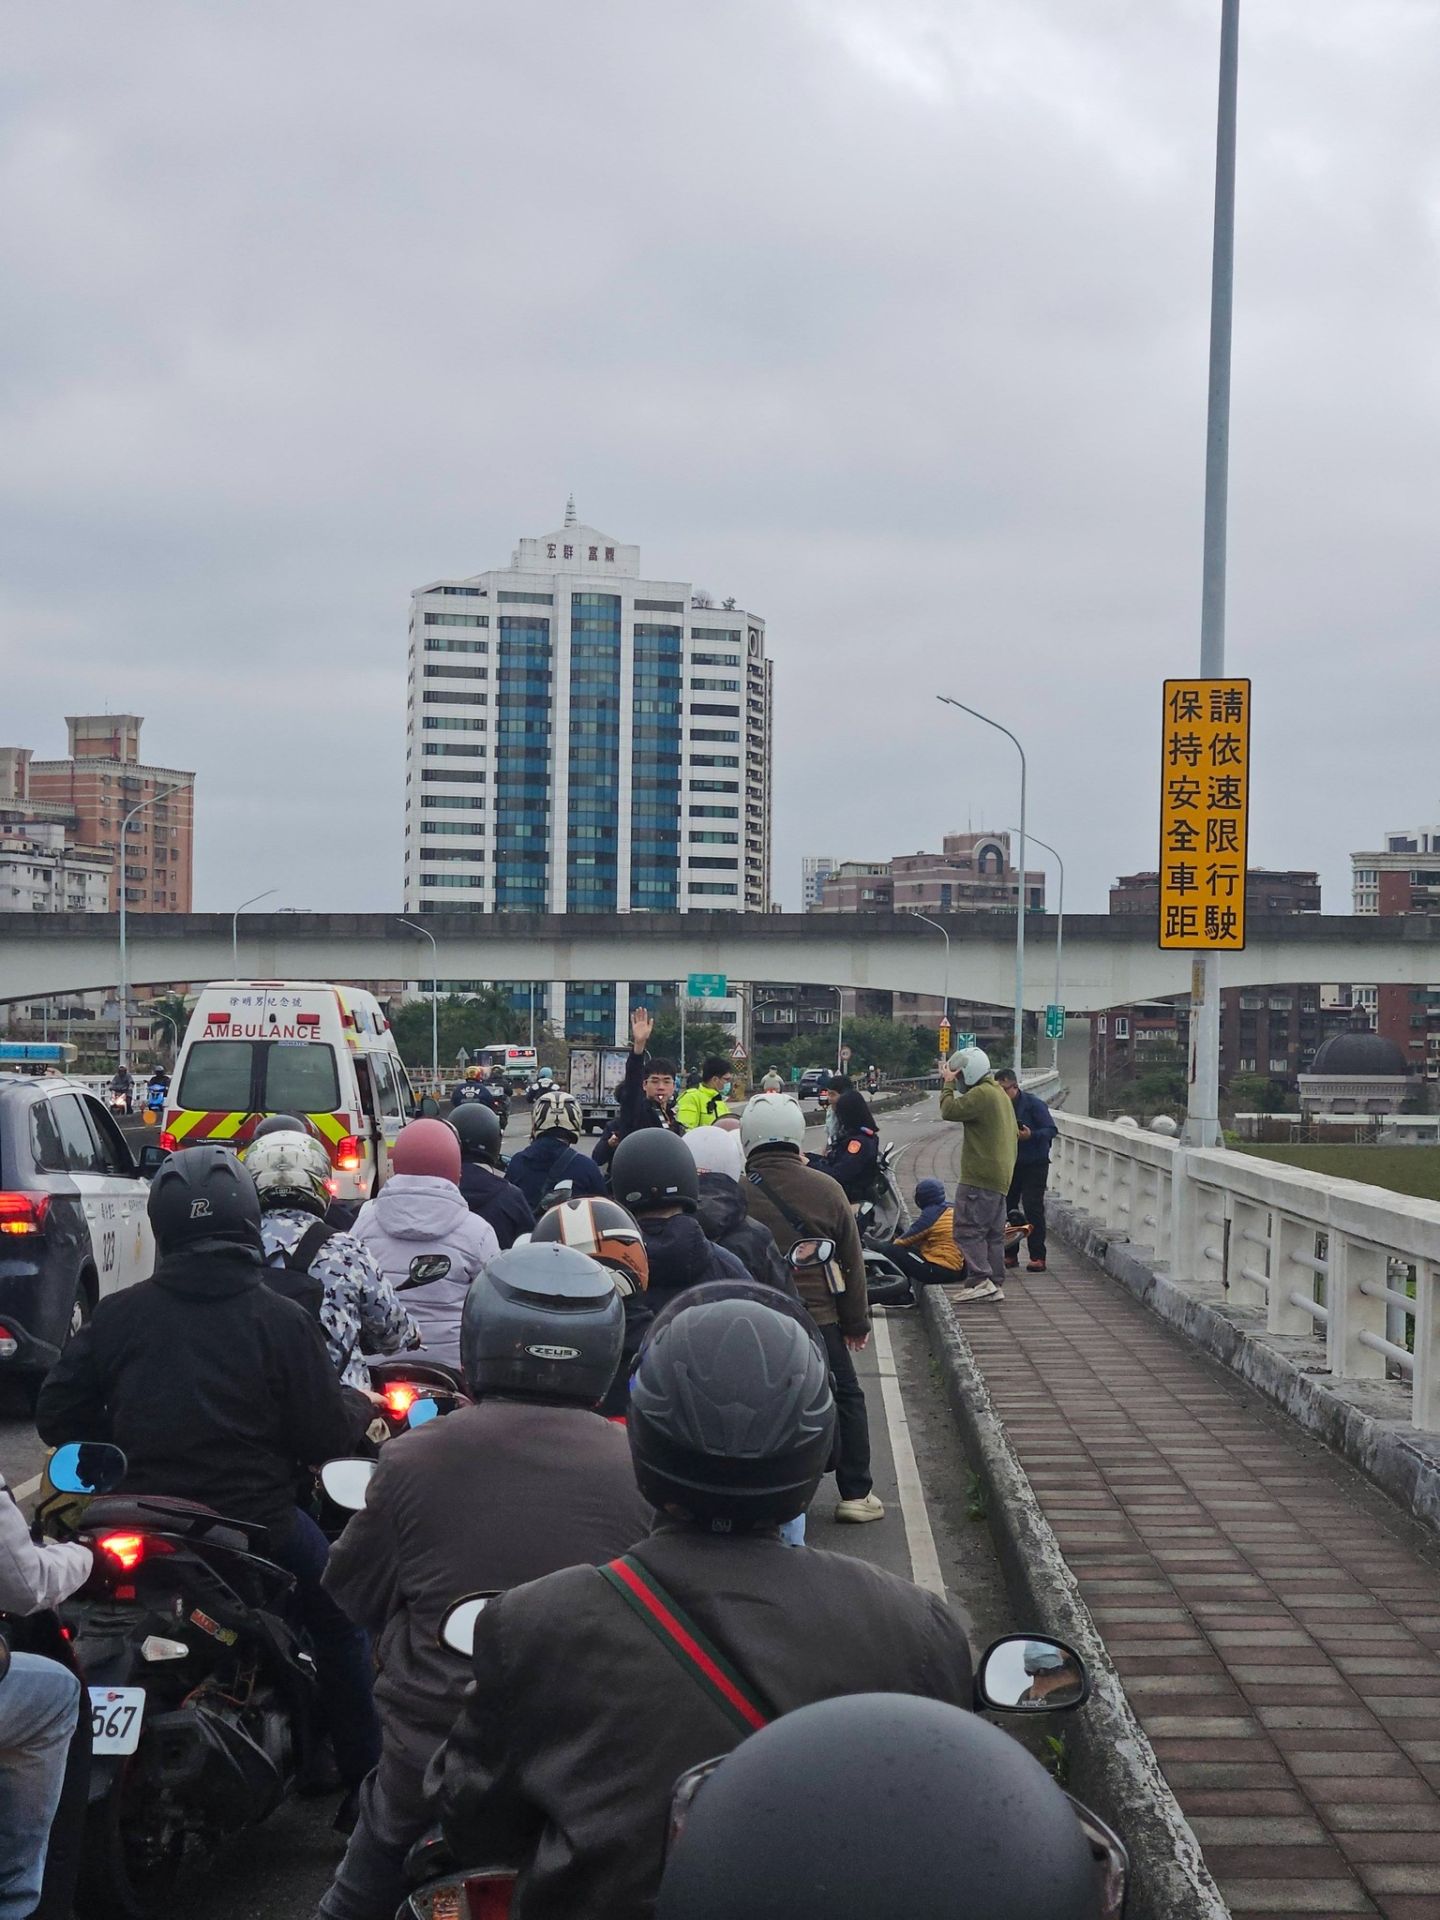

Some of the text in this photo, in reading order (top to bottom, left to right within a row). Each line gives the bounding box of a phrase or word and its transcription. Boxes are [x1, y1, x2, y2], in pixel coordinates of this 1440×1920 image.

[1165, 688, 1203, 940] 保持安全車距
[1204, 688, 1243, 941] 請依速限行駛
[203, 1023, 321, 1040] AMBULANCE
[534, 1347, 573, 1356] ZEUS
